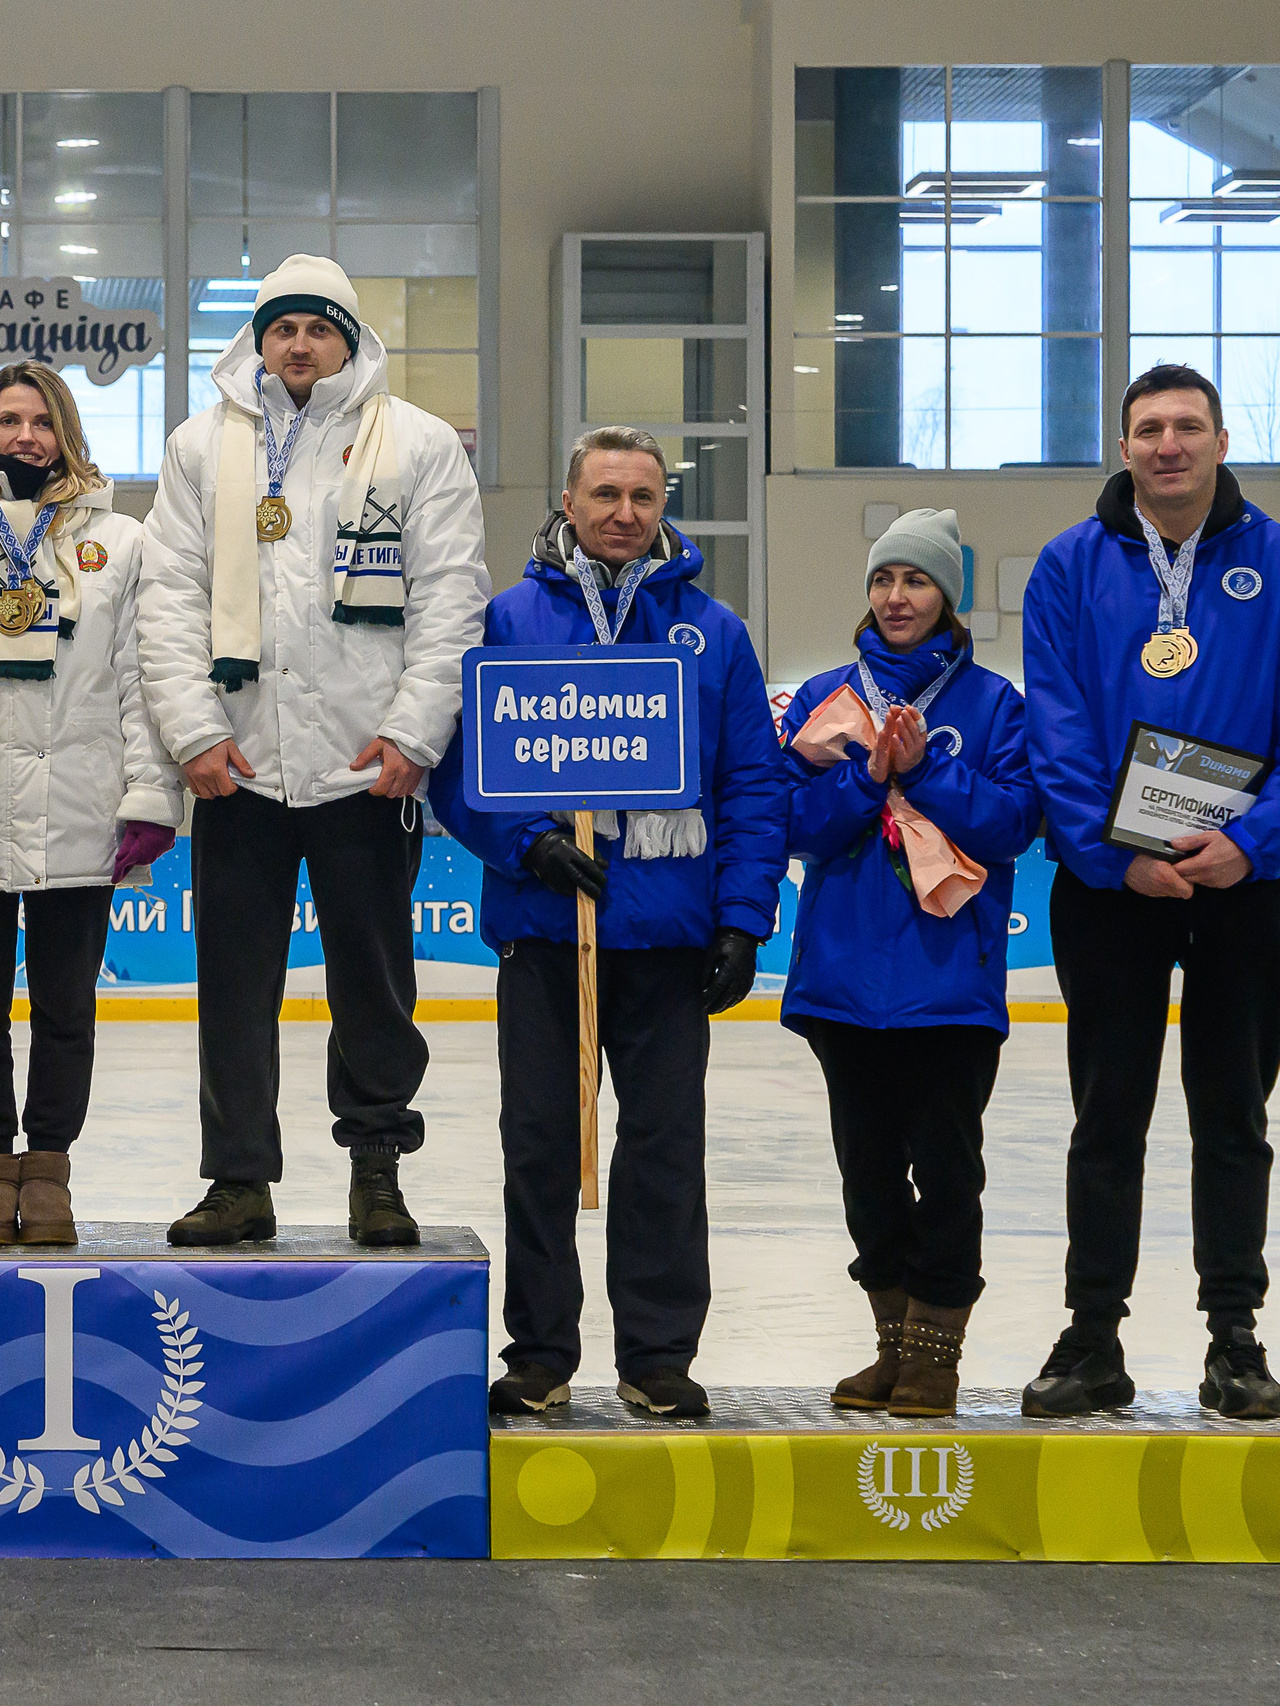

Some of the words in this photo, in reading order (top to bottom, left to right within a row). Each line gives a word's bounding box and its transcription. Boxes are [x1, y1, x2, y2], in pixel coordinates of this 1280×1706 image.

[368, 547, 401, 565] ТИГР
[493, 682, 667, 723] Академия
[514, 734, 648, 773] сервиса
[1141, 785, 1235, 822] СЕРТИФИКАТ
[878, 1447, 955, 1497] III
